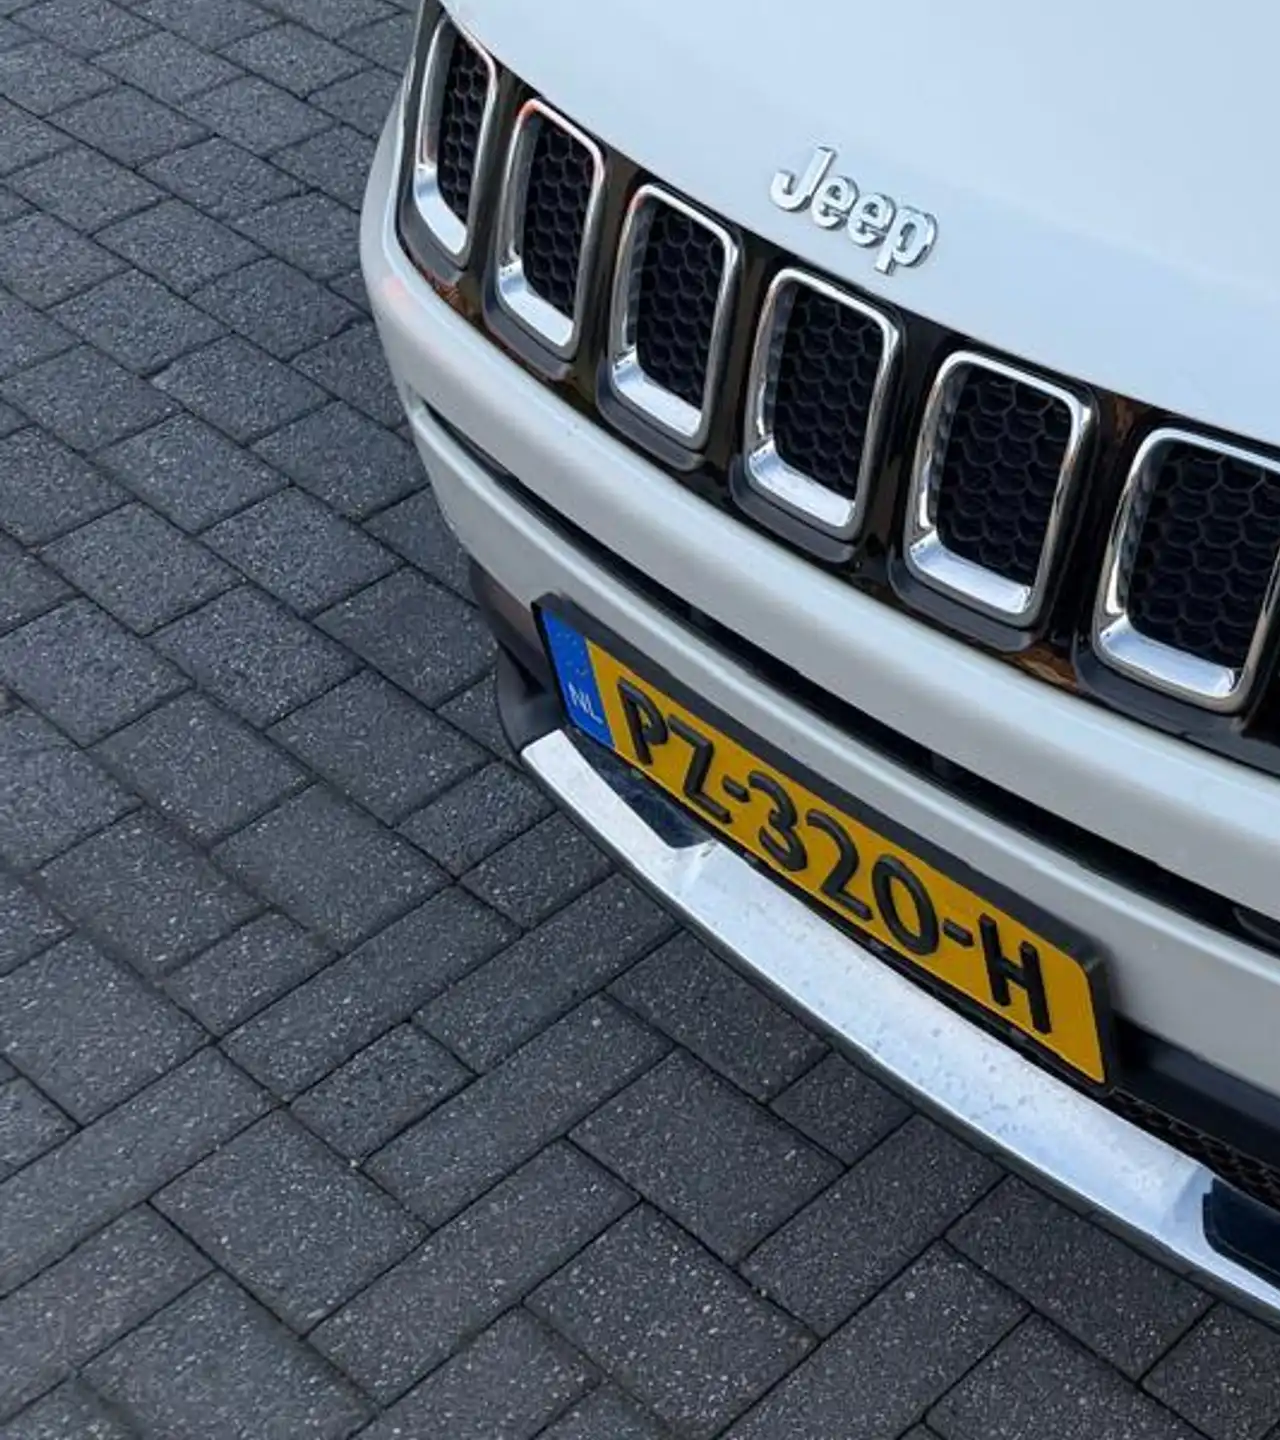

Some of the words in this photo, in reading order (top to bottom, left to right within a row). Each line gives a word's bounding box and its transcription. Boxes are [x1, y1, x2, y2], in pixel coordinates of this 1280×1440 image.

[769, 146, 938, 276] Jeep
[567, 681, 604, 725] NL
[615, 674, 1052, 1036] PZ-320-H
